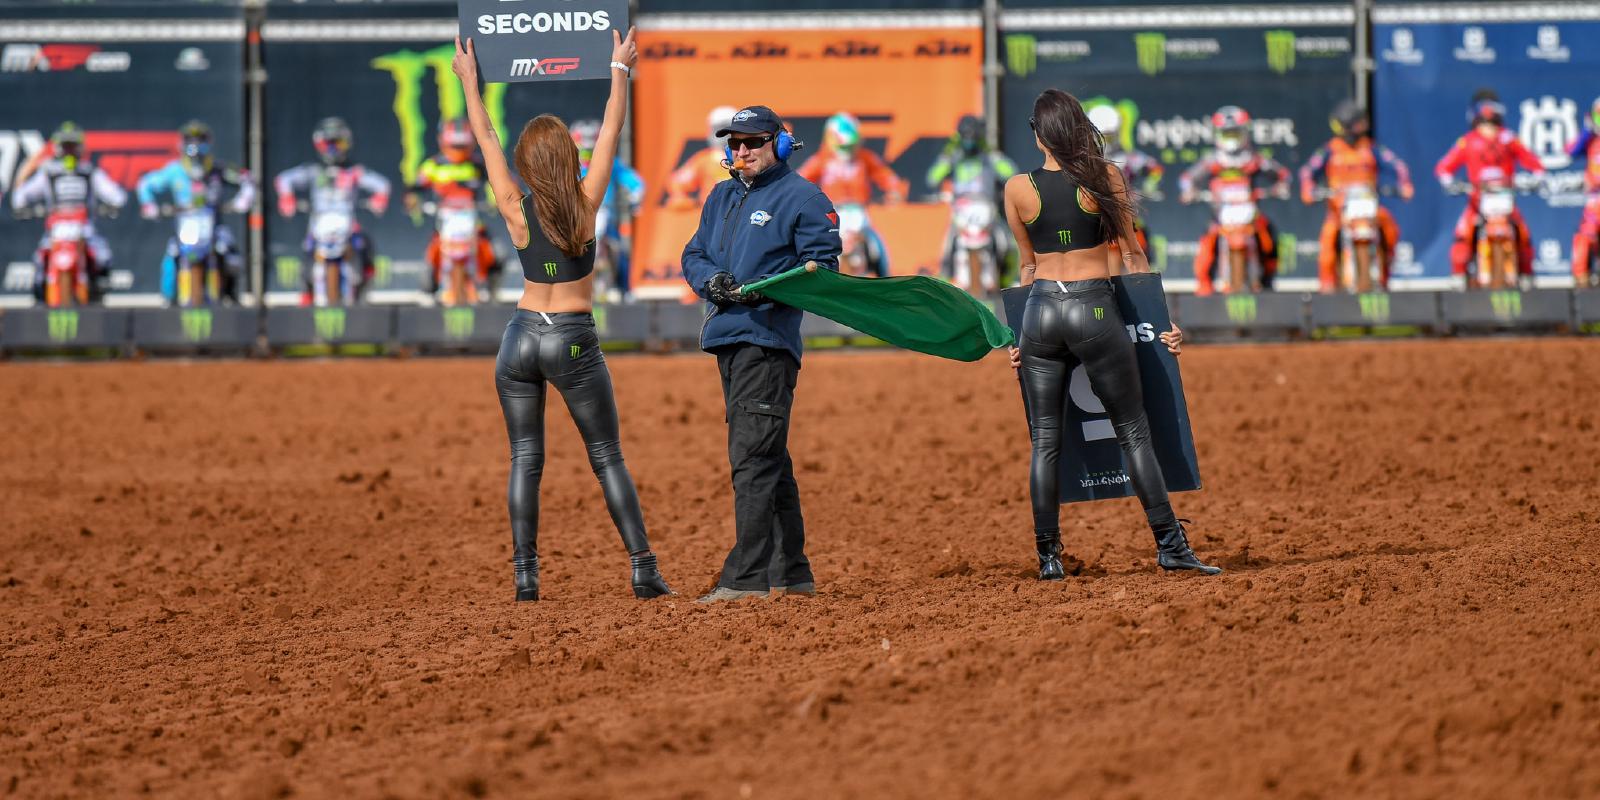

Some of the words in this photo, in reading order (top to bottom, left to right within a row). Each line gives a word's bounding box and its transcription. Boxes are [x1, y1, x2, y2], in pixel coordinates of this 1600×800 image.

[477, 10, 610, 35] SECONDS
[510, 57, 581, 76] MXGP
[1136, 116, 1298, 148] MONER
[1080, 475, 1130, 487] MONSTER
